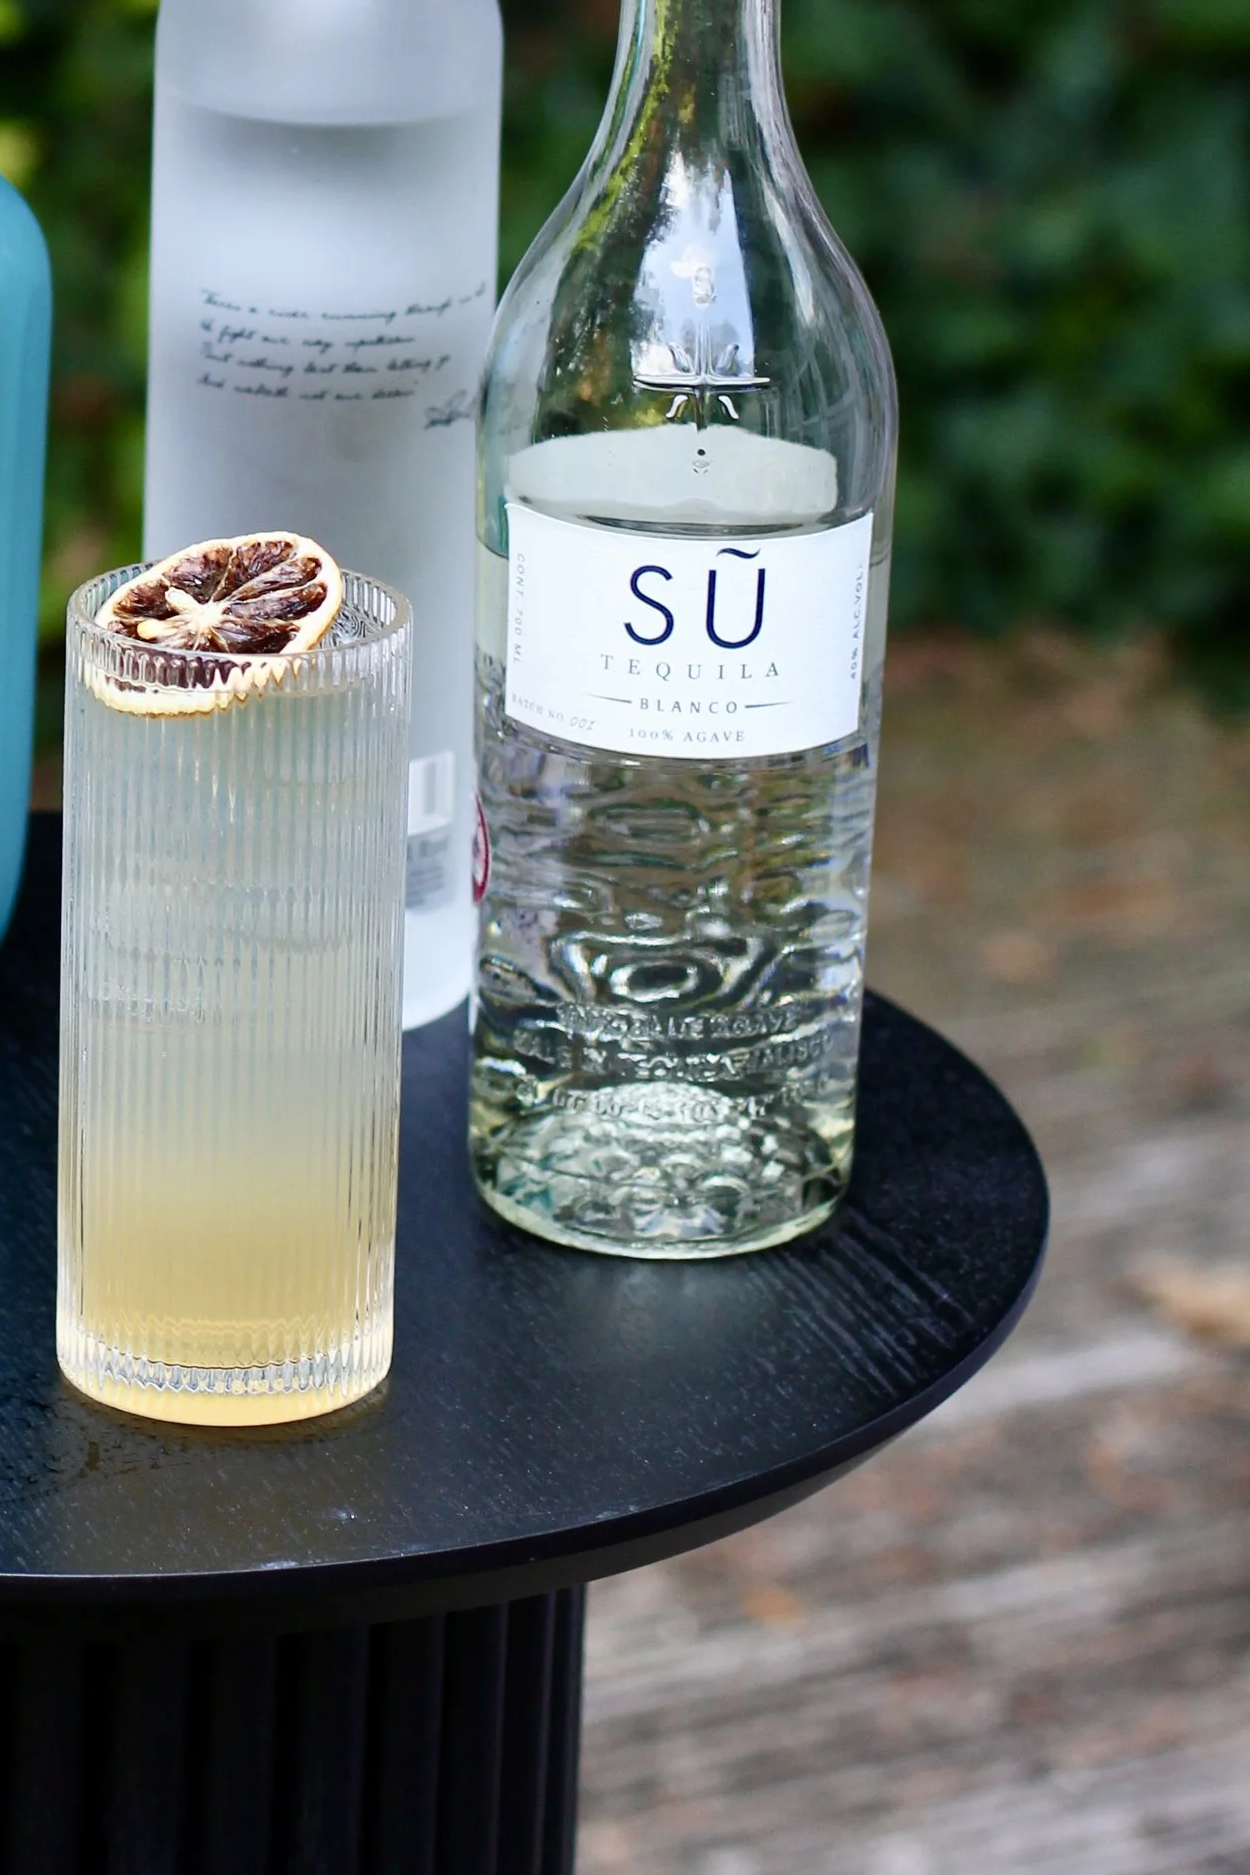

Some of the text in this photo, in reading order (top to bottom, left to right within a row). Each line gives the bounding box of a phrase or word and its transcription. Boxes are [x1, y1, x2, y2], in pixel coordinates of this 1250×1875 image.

[623, 546, 766, 650] SŨ
[600, 653, 780, 682] TEQUILA
[639, 697, 738, 715] BLANCO
[628, 727, 747, 744] 100% AGAVE
